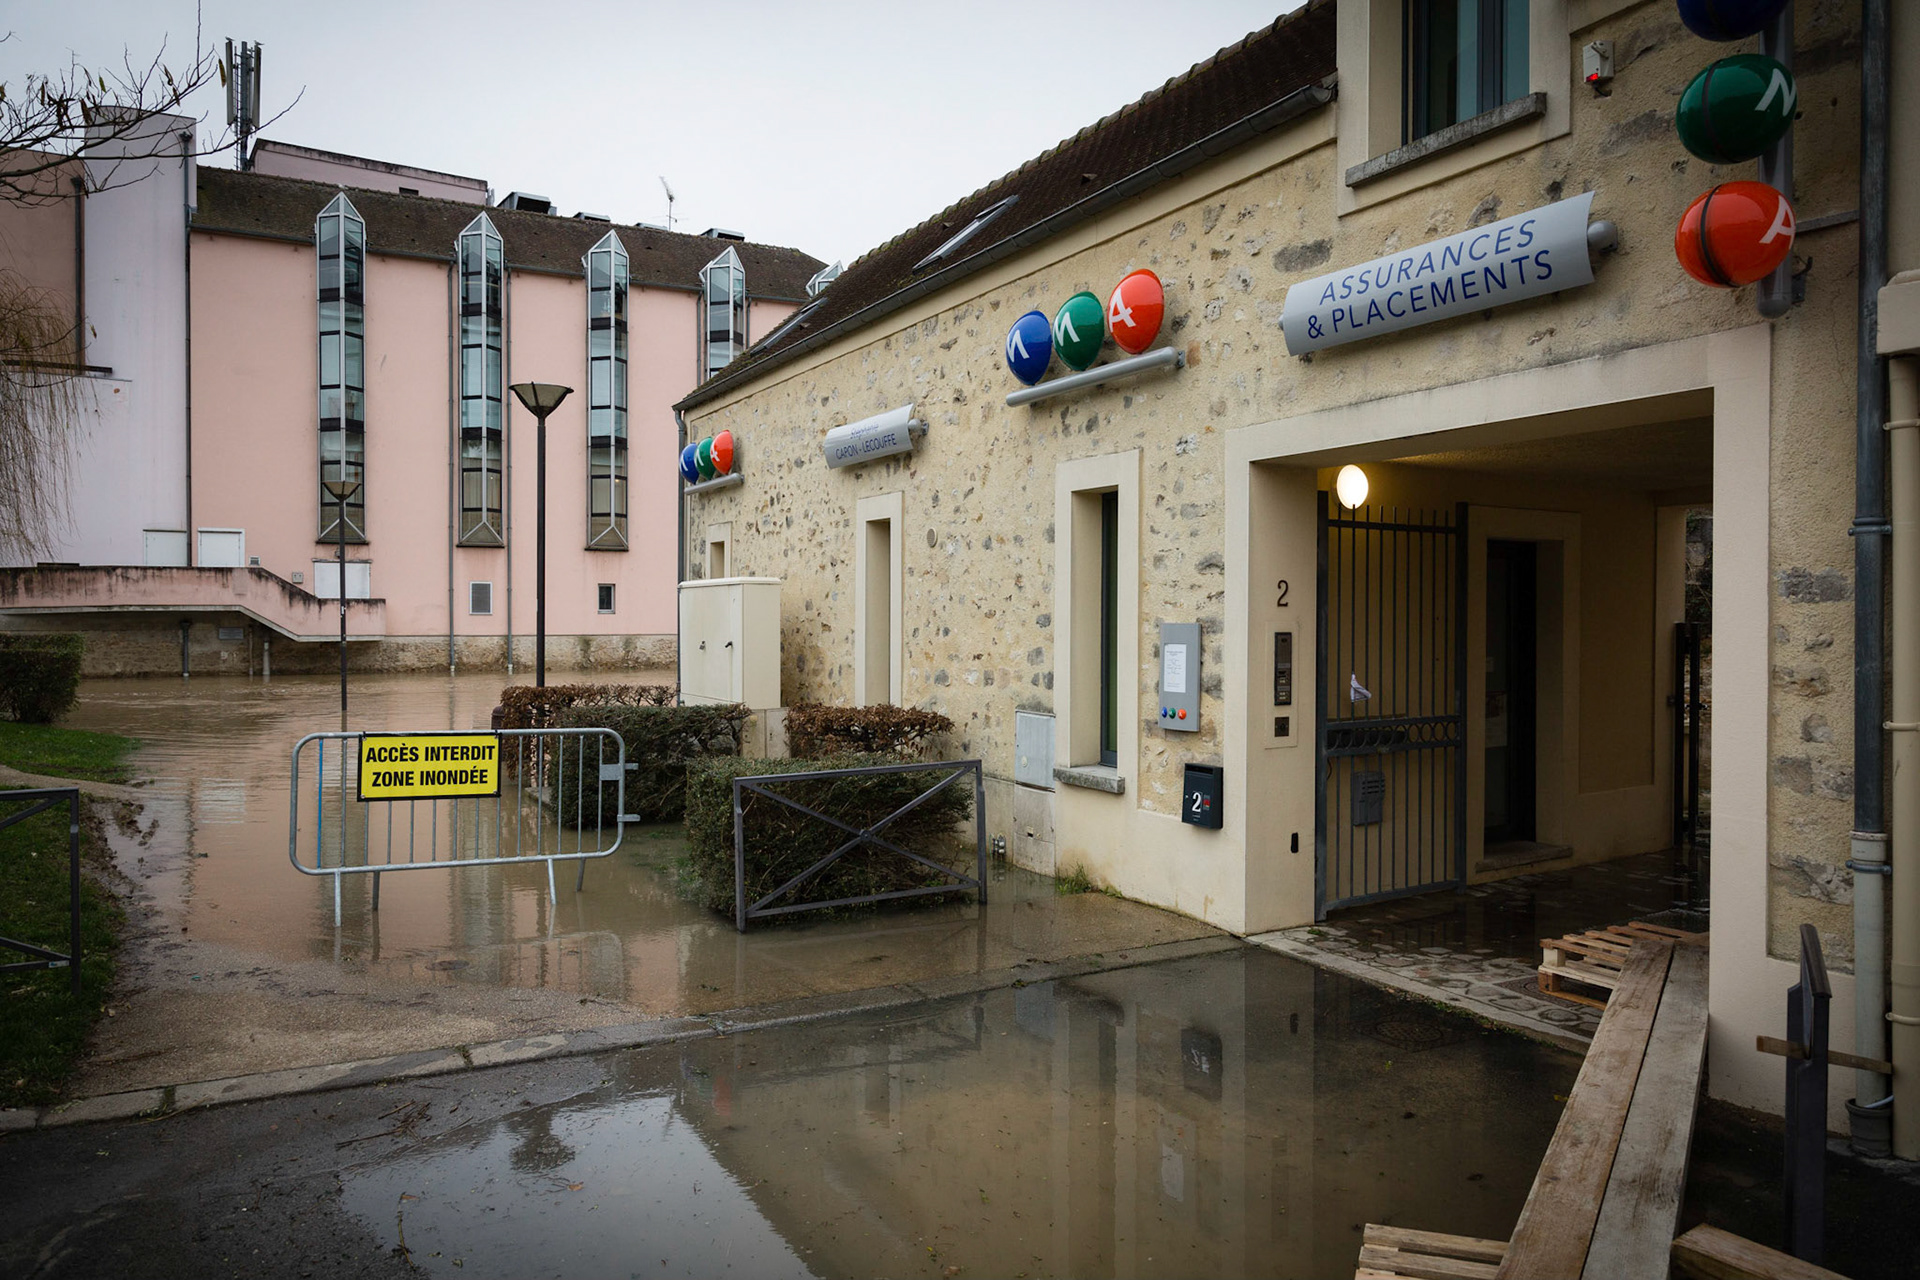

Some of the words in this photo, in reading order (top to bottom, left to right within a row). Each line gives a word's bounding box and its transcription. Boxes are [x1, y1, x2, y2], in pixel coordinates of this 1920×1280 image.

[1319, 219, 1536, 306] ASSURANCES
[1307, 314, 1325, 339] &
[1332, 250, 1553, 333] PLACEMENTS
[1277, 579, 1289, 607] 2
[365, 743, 419, 763] ACCÈS
[424, 745, 496, 762] INTERDIT
[371, 770, 415, 787] ZONE
[419, 765, 488, 786] INONDÉE
[1191, 792, 1202, 812] 2
